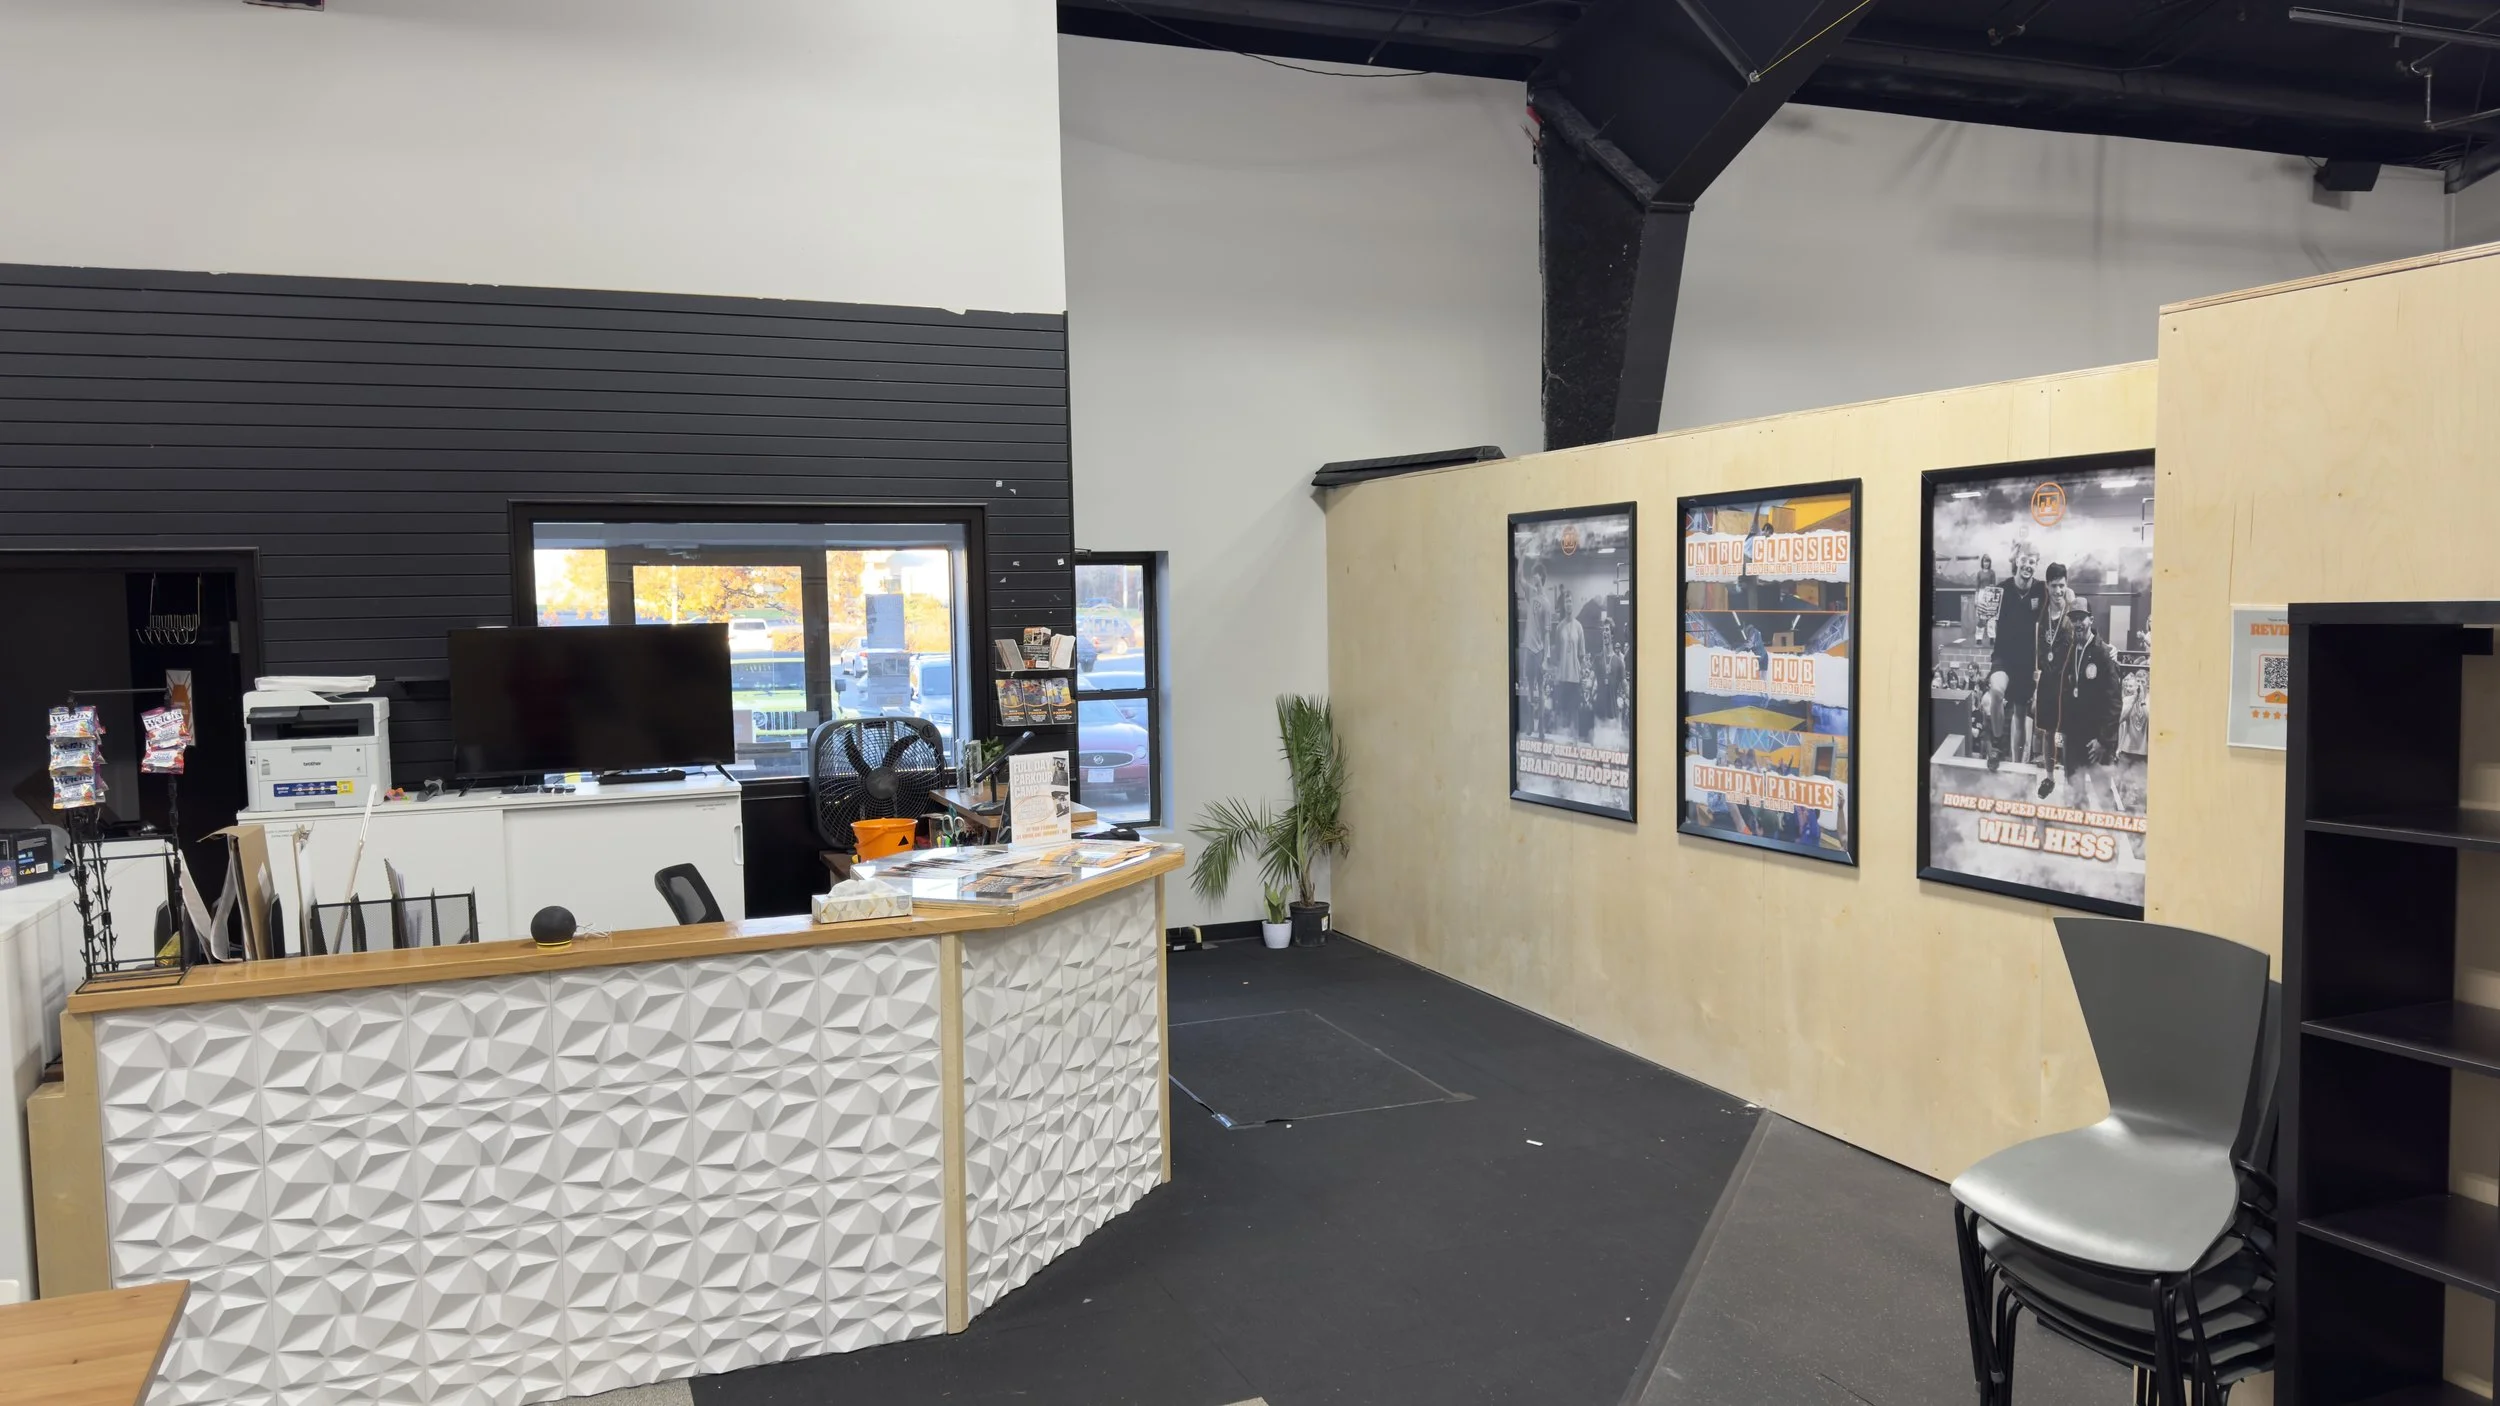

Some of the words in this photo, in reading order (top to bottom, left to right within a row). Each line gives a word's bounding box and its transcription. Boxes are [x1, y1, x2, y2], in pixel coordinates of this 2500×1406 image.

[1687, 541, 1743, 567] INTRO
[1753, 535, 1847, 562] CLASSES
[2250, 623, 2289, 636] REVI
[1711, 655, 1760, 680] CAMP
[1772, 658, 1814, 684] HUB
[1013, 761, 1033, 774] FULL
[1035, 760, 1052, 772] DAY
[1520, 740, 1542, 753] HOME
[1542, 743, 1554, 755] OF
[1554, 745, 1579, 759] SKILL
[1580, 748, 1629, 766] CHAMPION
[1014, 771, 1053, 786] PARKOUR
[1520, 756, 1576, 779] BRANDON
[1576, 764, 1629, 788] HOOPER
[1694, 765, 1762, 795] BIRTHDAY
[1769, 776, 1833, 807] PARTIES
[1014, 785, 1039, 798] CAMP
[1944, 793, 1976, 810] HOME
[1977, 797, 1994, 812] OF
[1995, 800, 2035, 818] SPEED
[2037, 805, 2084, 824] SILVER
[2084, 811, 2147, 833] MEDALIS
[1979, 818, 2040, 849] WILL
[2043, 827, 2115, 861] HESS
